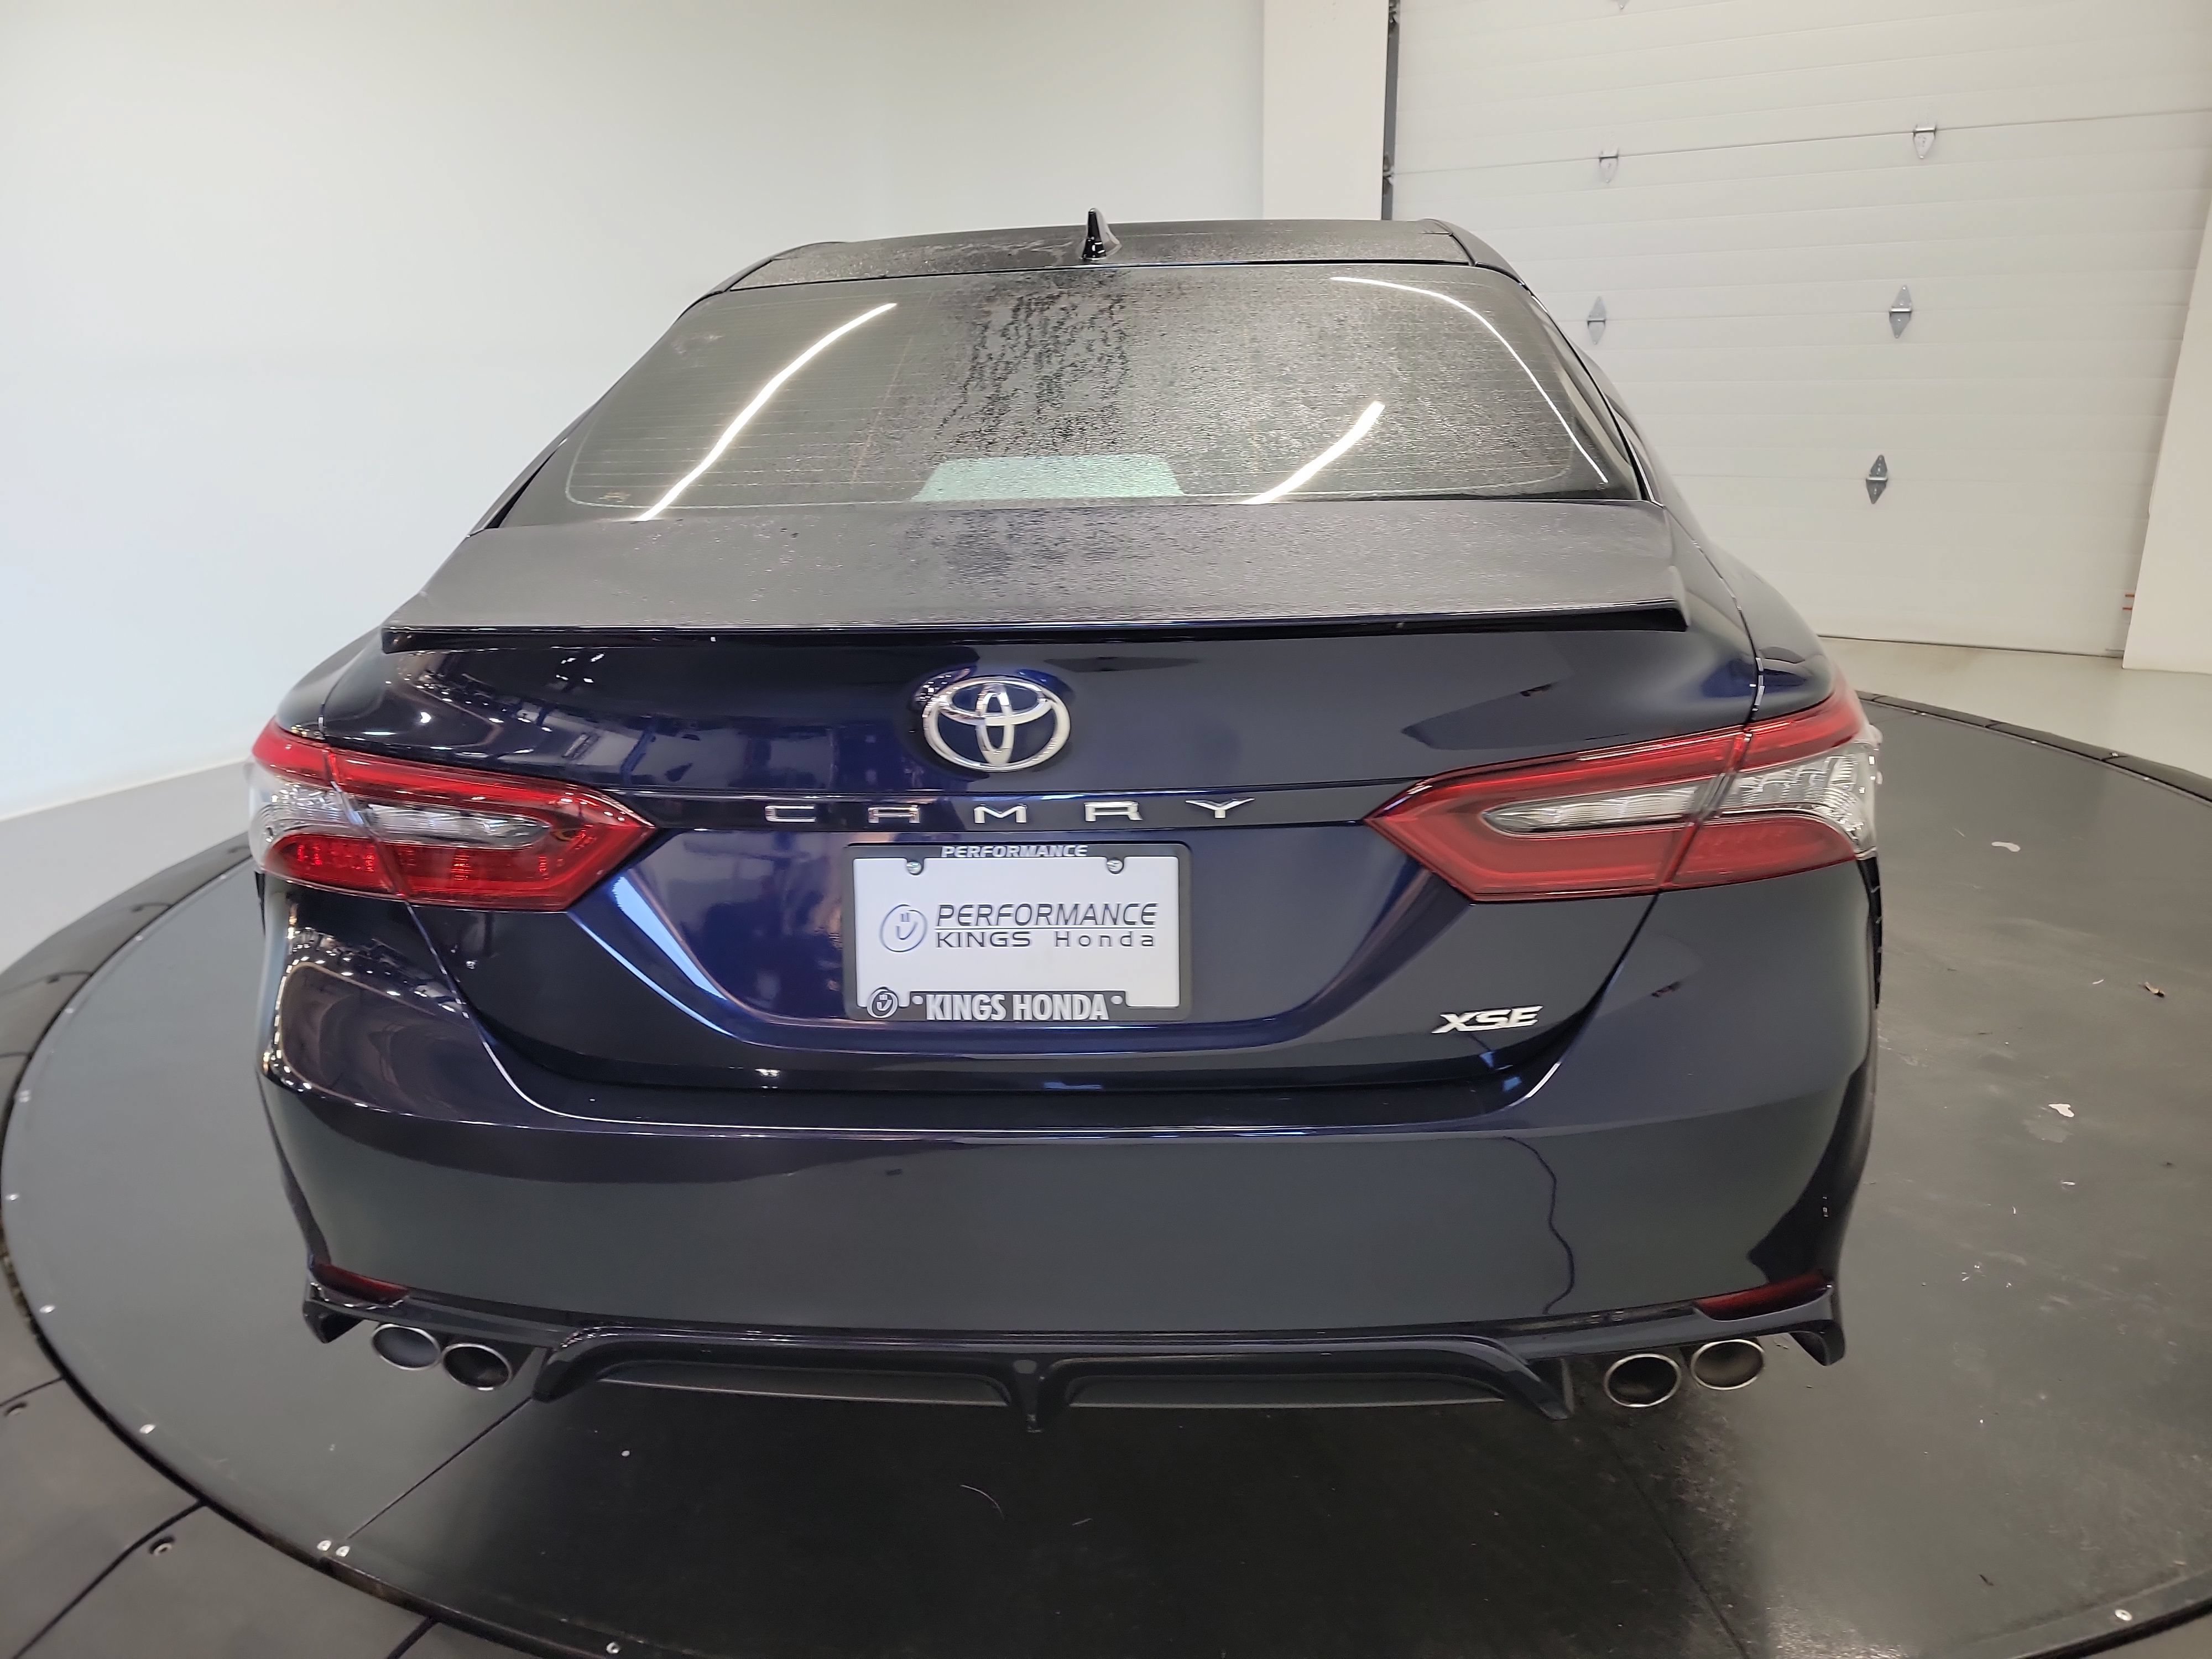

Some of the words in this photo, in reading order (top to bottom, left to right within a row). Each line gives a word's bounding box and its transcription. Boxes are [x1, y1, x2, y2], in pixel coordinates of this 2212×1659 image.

[765, 797, 1255, 823] CAMRY
[941, 844, 1088, 858] PERFORMANCE
[936, 903, 1158, 926] PERFORMANCE
[936, 931, 1031, 948] KINGS
[1054, 931, 1155, 947] Honda
[926, 994, 1006, 1020] KINGS
[1013, 994, 1109, 1020] HONDA
[1431, 1004, 1544, 1034] XSE
